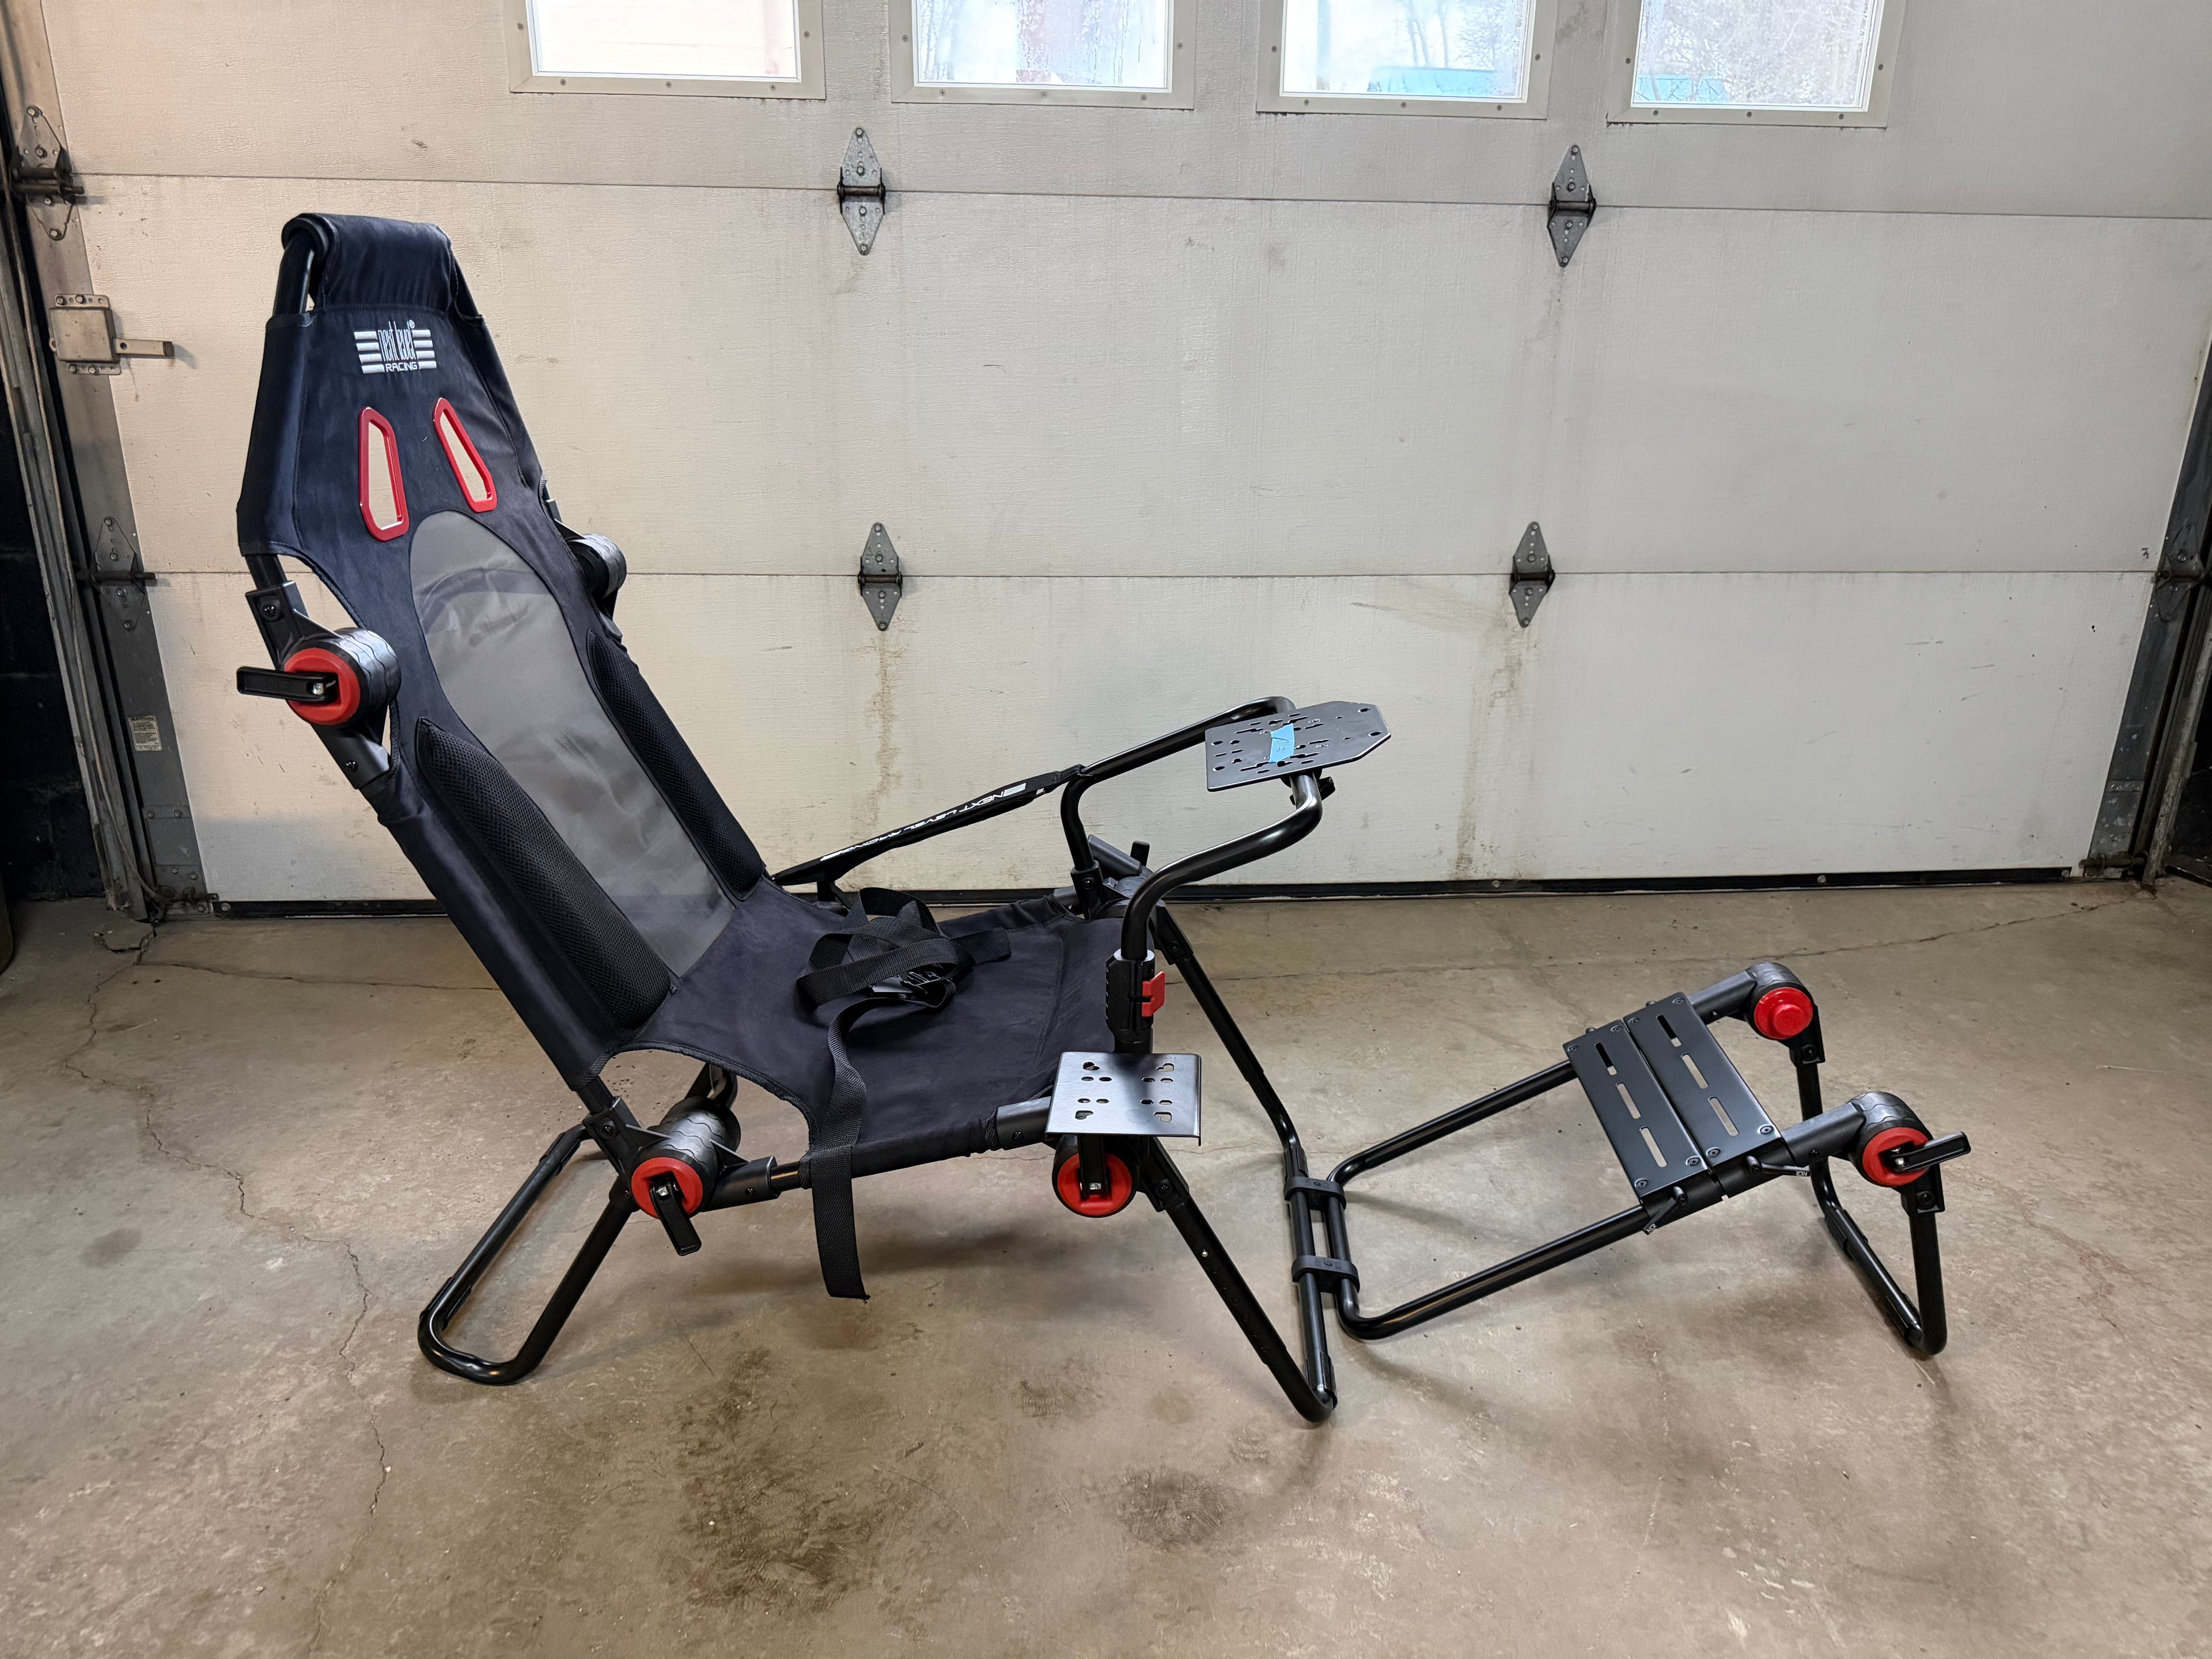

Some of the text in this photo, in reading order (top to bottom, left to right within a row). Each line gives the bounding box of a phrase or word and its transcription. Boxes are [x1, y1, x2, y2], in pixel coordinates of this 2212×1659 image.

[377, 321, 400, 362] next
[385, 361, 418, 373] RACING
[842, 791, 1004, 854] NEXT LEVEL RACING
